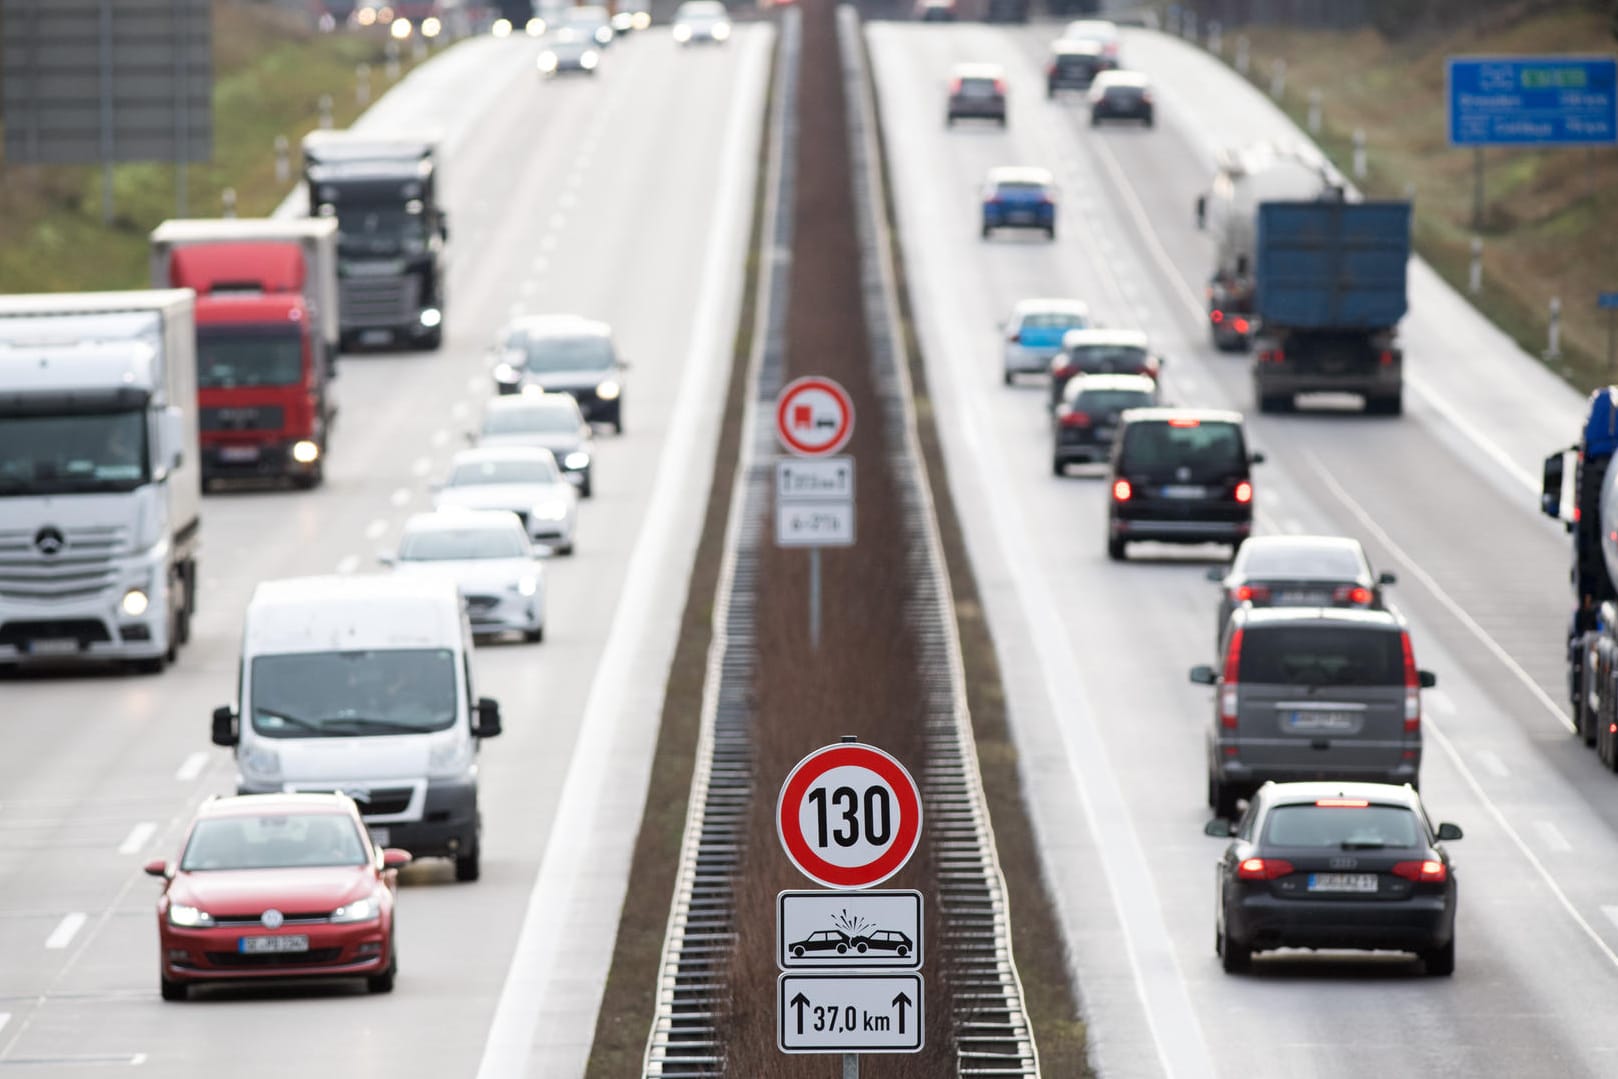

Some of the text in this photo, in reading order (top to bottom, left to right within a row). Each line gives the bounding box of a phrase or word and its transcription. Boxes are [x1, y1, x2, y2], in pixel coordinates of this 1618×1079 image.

[808, 786, 891, 848] 130
[813, 1006, 891, 1034] 37,0 km
